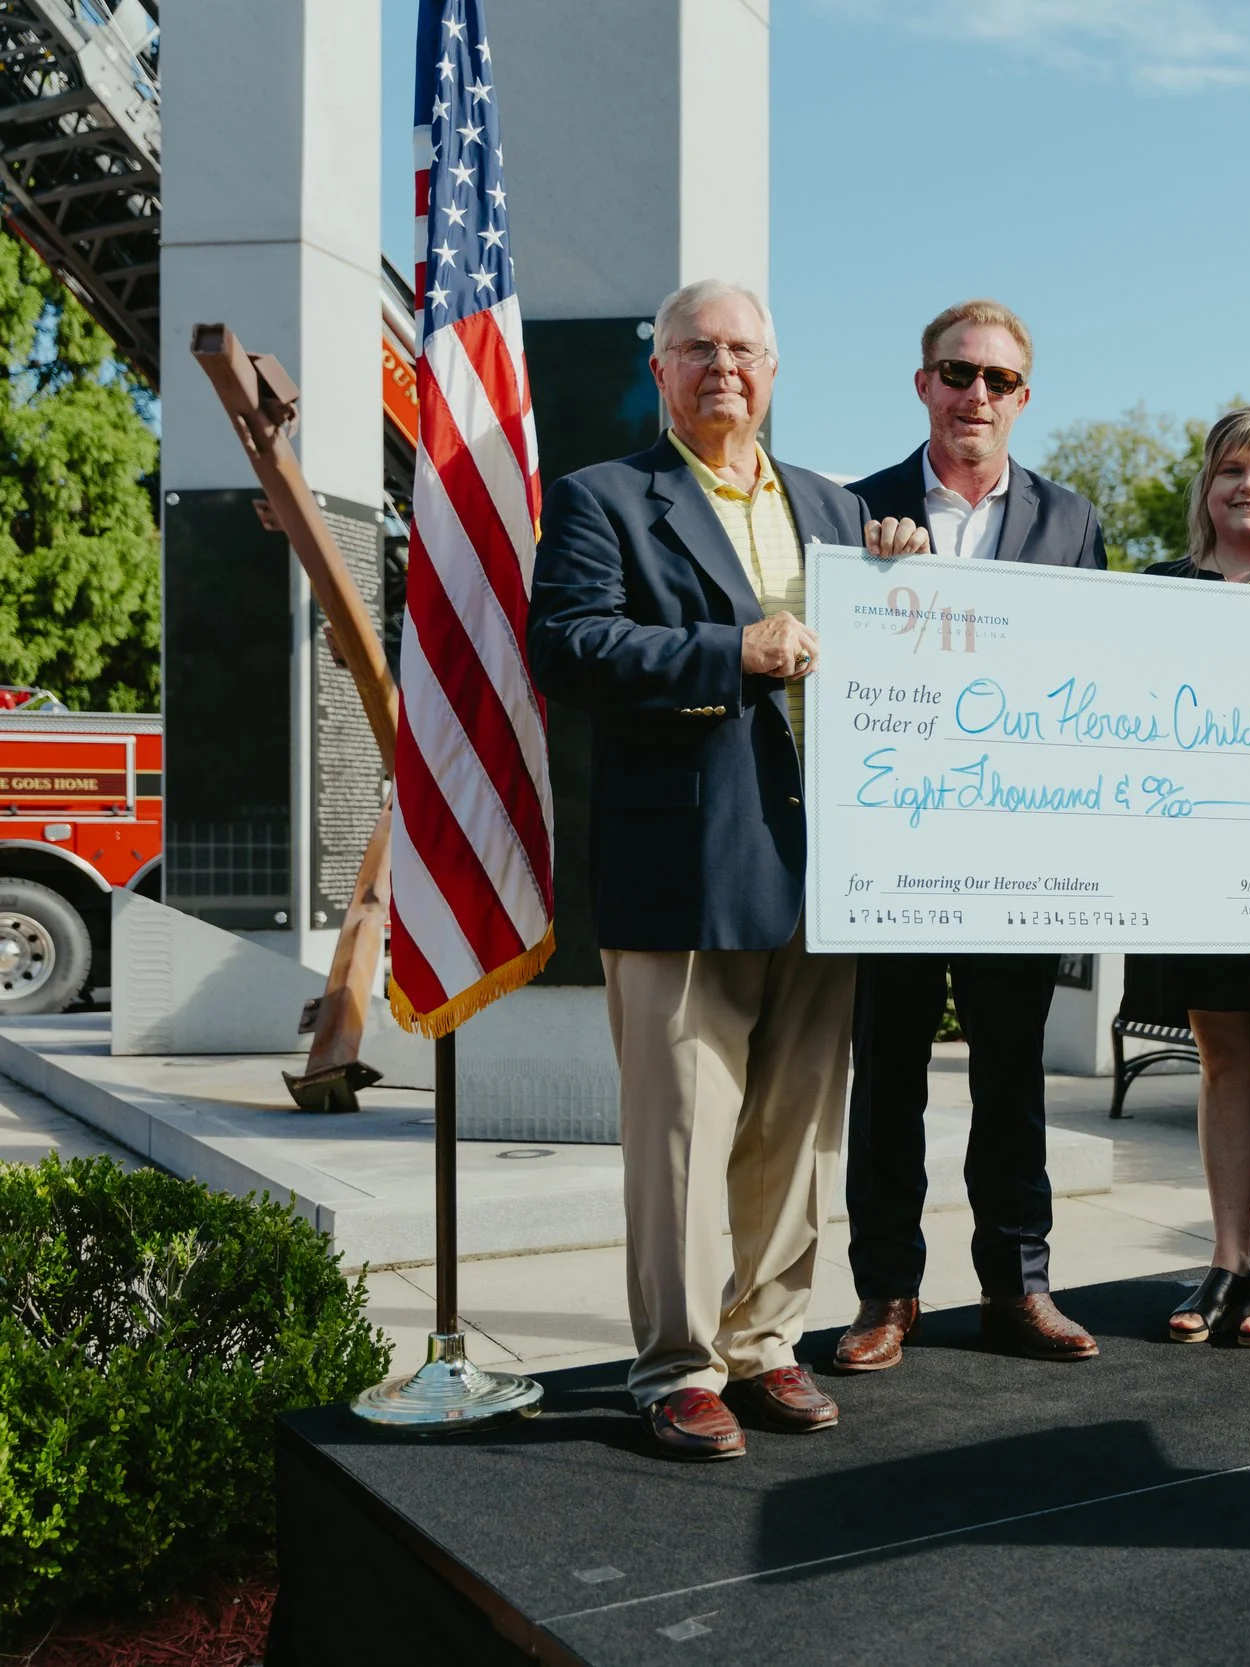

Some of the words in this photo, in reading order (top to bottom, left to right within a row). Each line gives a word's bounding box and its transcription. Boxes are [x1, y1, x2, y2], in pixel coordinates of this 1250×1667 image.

[853, 621, 870, 629] OF
[854, 605, 937, 620] REMEMBRANCE
[940, 612, 1009, 626] FOUNDATION
[887, 586, 977, 655] 9/11
[845, 680, 882, 706] Pay
[888, 685, 906, 703] to
[913, 684, 942, 704] the
[956, 678, 1045, 740] Our
[853, 712, 912, 733] Order
[917, 715, 938, 740] of
[12, 777, 52, 790] GOES
[55, 778, 98, 791] HOME
[857, 748, 956, 828] Eight
[950, 754, 1102, 812] Thousand
[1114, 774, 1130, 810] &
[844, 873, 873, 897] for
[895, 874, 961, 893] Honoring
[964, 875, 991, 890] Our
[1044, 877, 1099, 892] Children
